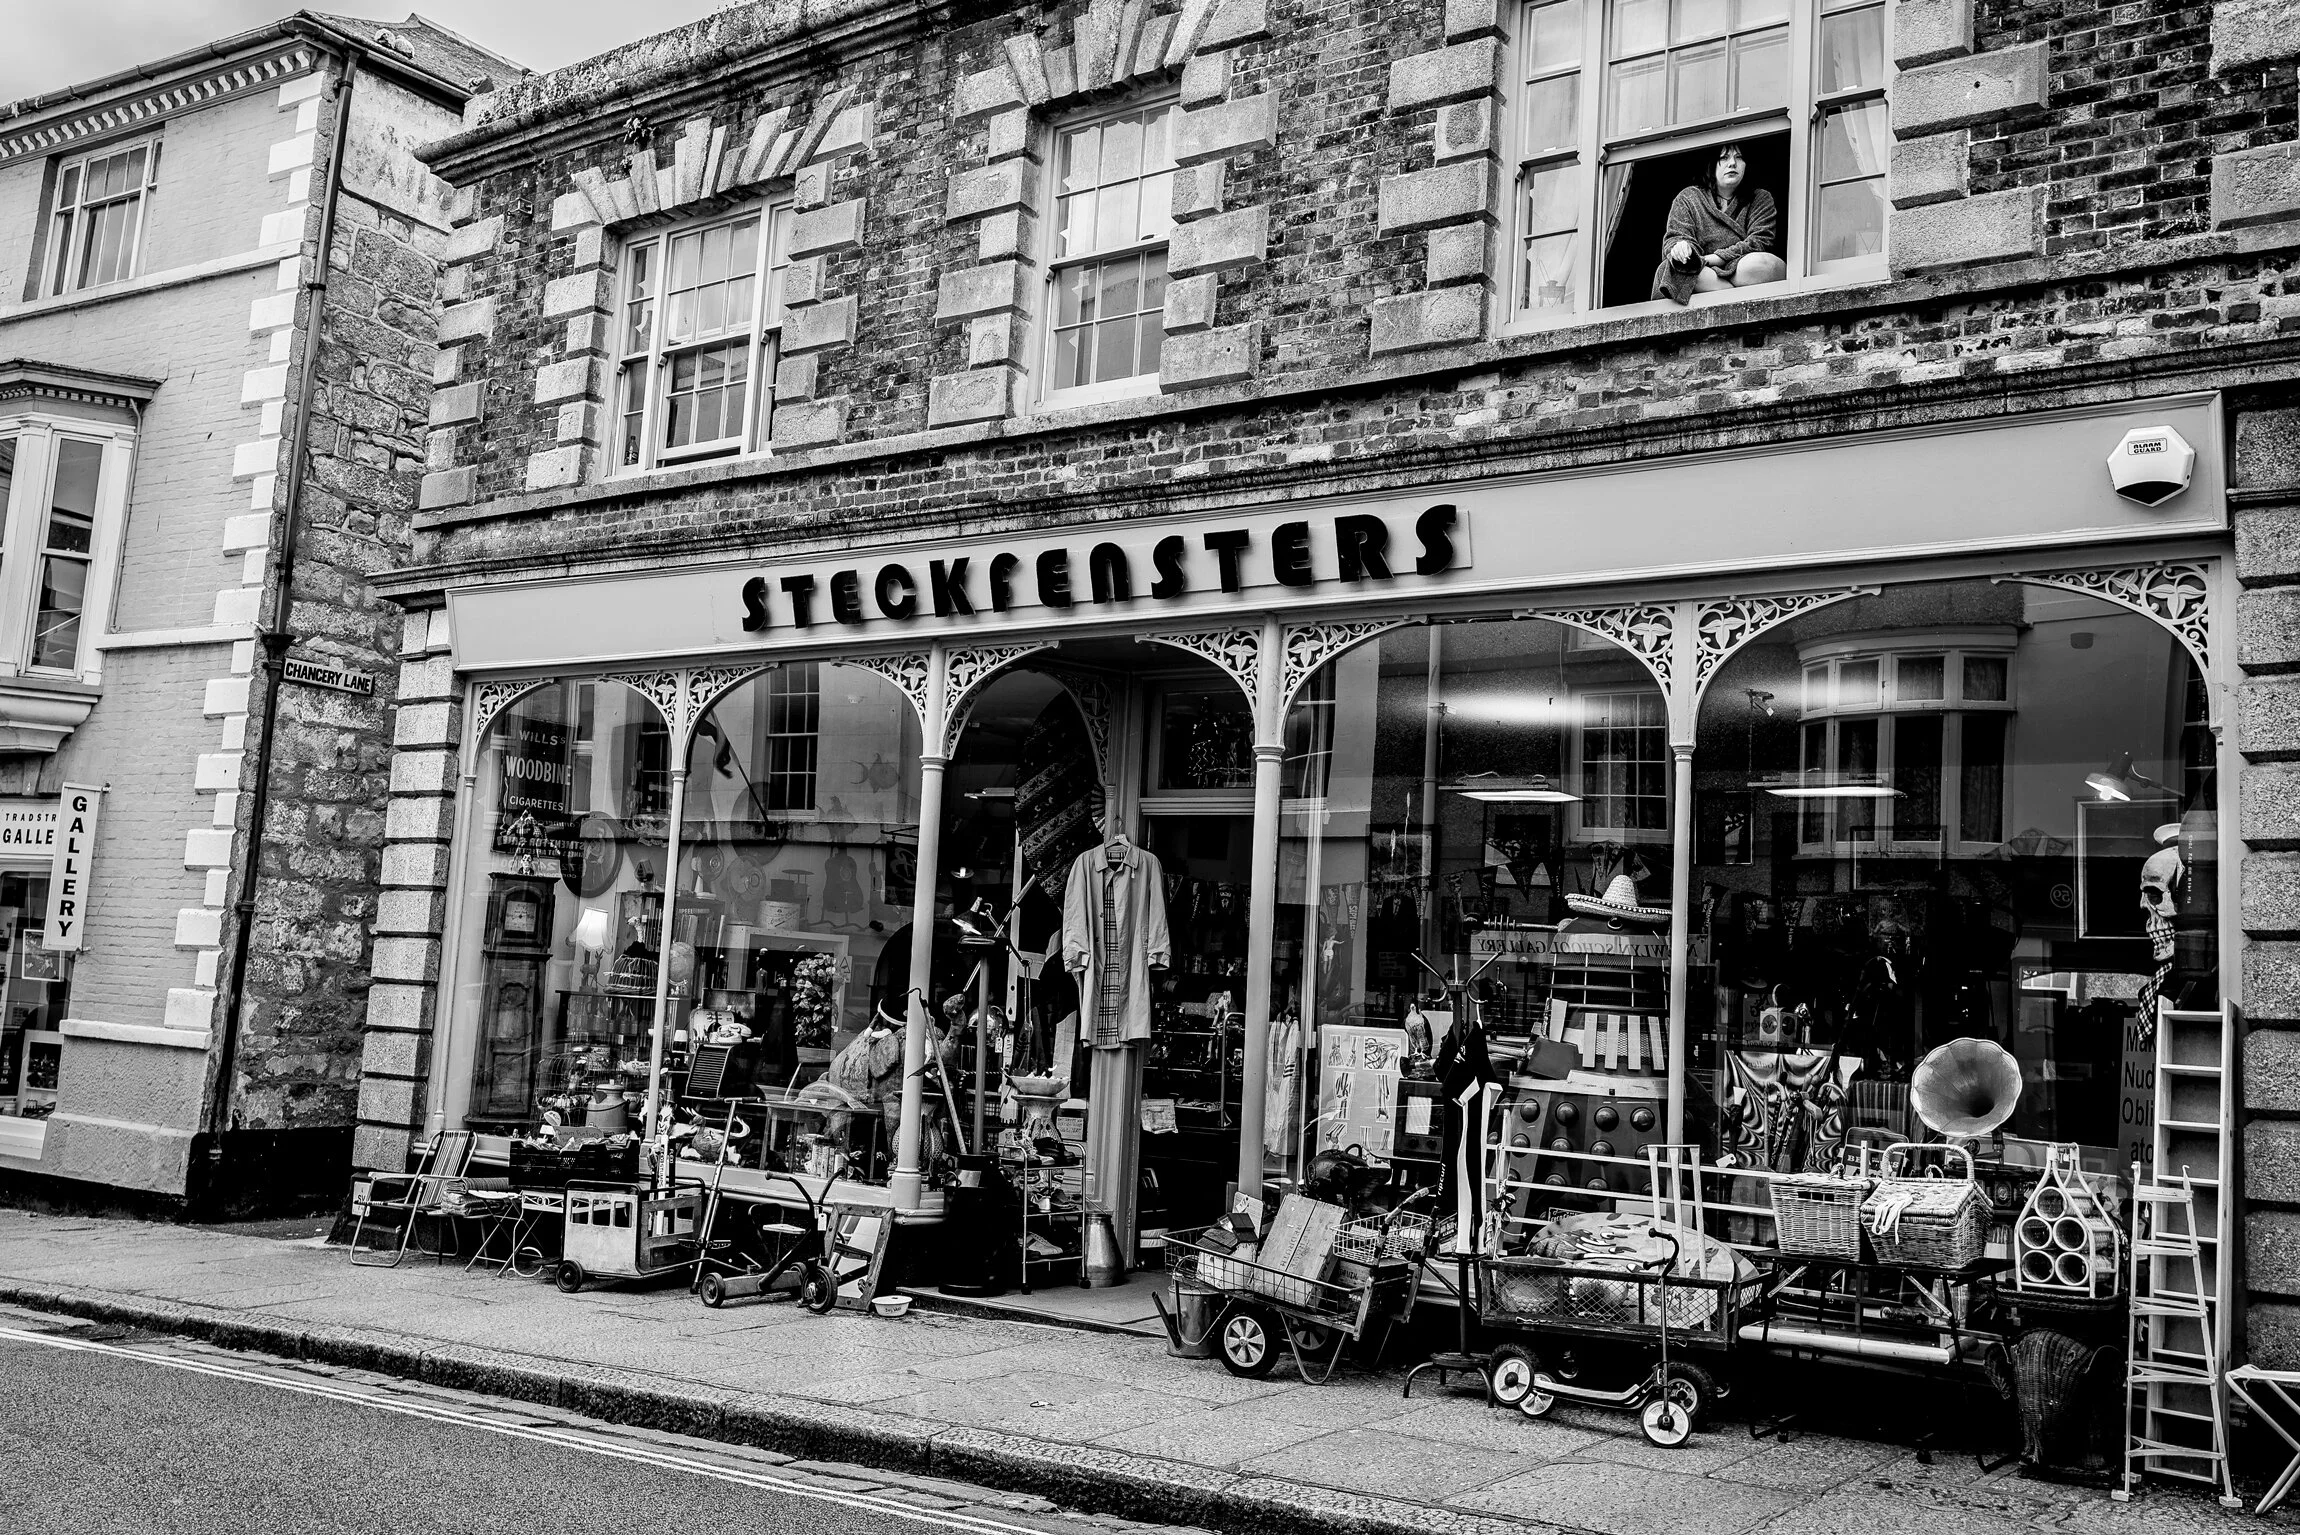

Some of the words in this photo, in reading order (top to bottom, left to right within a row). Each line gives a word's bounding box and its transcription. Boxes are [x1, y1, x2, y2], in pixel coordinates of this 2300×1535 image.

[741, 503, 1458, 633] STECKFENSTERS
[285, 662, 342, 686] CHANCERY
[343, 673, 371, 692] LANE
[505, 755, 572, 786] WOODBINE
[509, 795, 565, 812] CIGARETTES
[2, 828, 55, 845] GALLE
[57, 795, 88, 937] GALLERY
